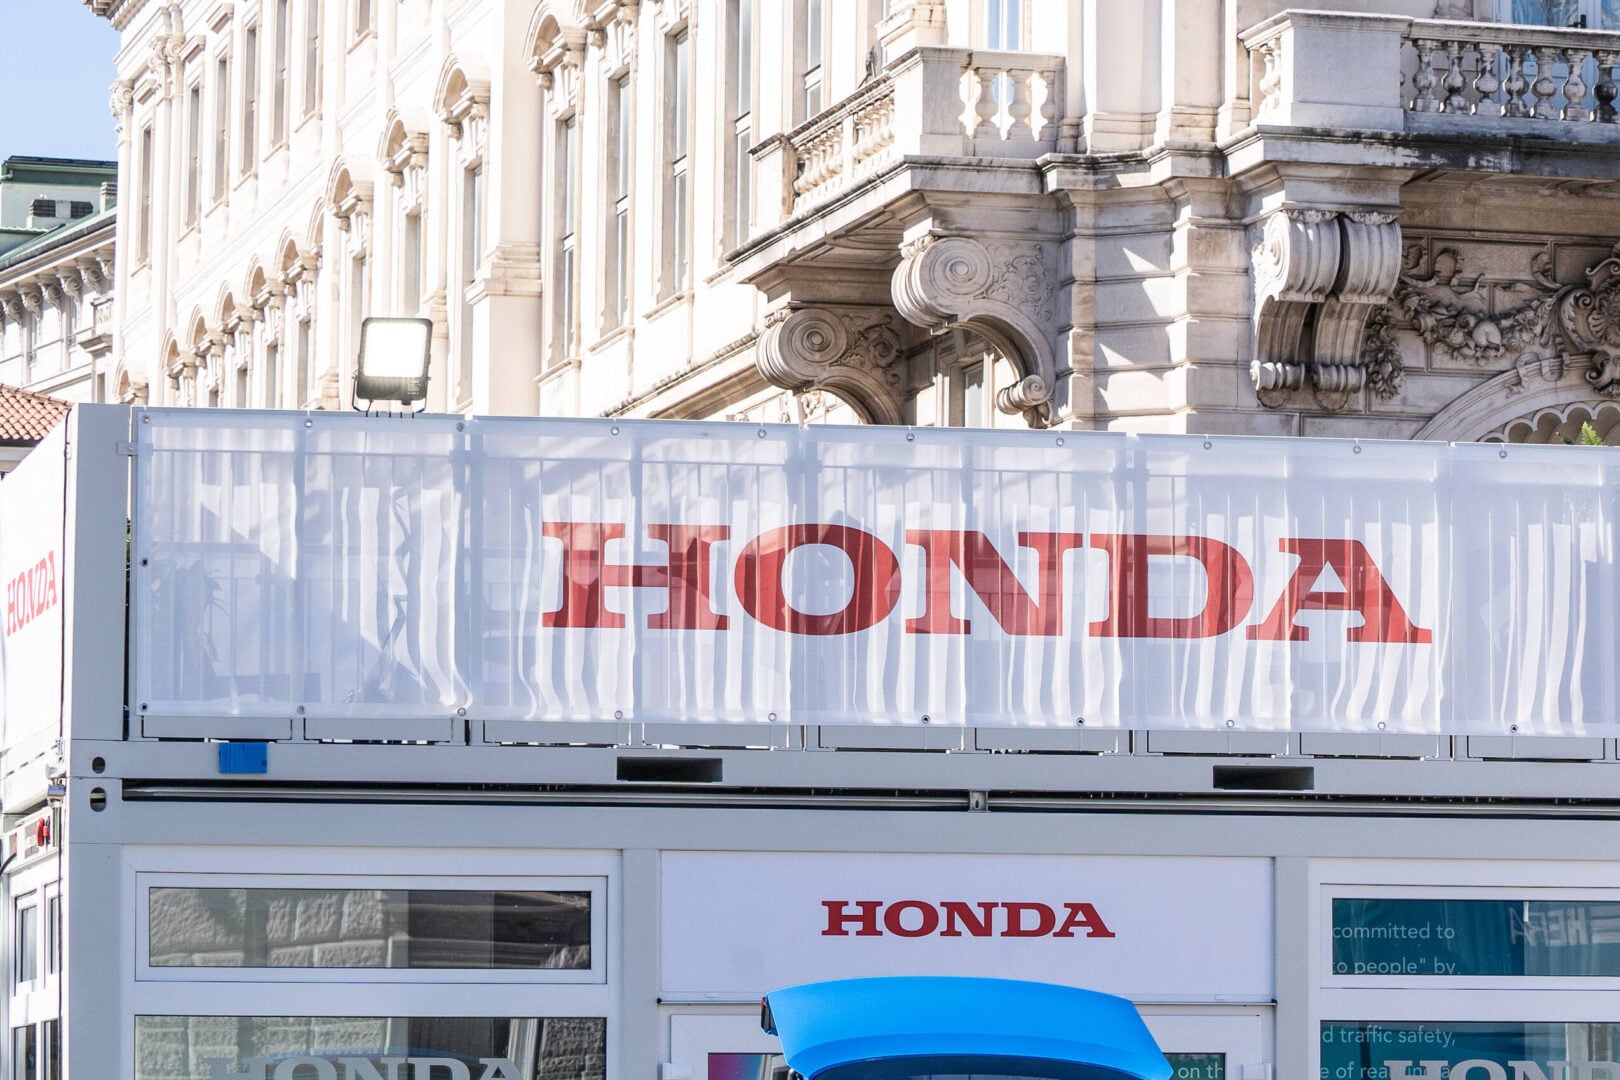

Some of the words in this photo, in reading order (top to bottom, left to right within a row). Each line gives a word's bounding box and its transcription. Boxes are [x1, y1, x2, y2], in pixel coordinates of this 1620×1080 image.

[7, 550, 57, 637] HONDA
[542, 522, 1433, 643] HONDA
[821, 900, 1116, 938] HONDA
[1332, 922, 1430, 940] committed
[1436, 924, 1456, 940] to
[1340, 1025, 1392, 1043] traffic
[1398, 1025, 1456, 1048] safety,
[1178, 1067, 1200, 1079] on
[1336, 1061, 1354, 1078] of
